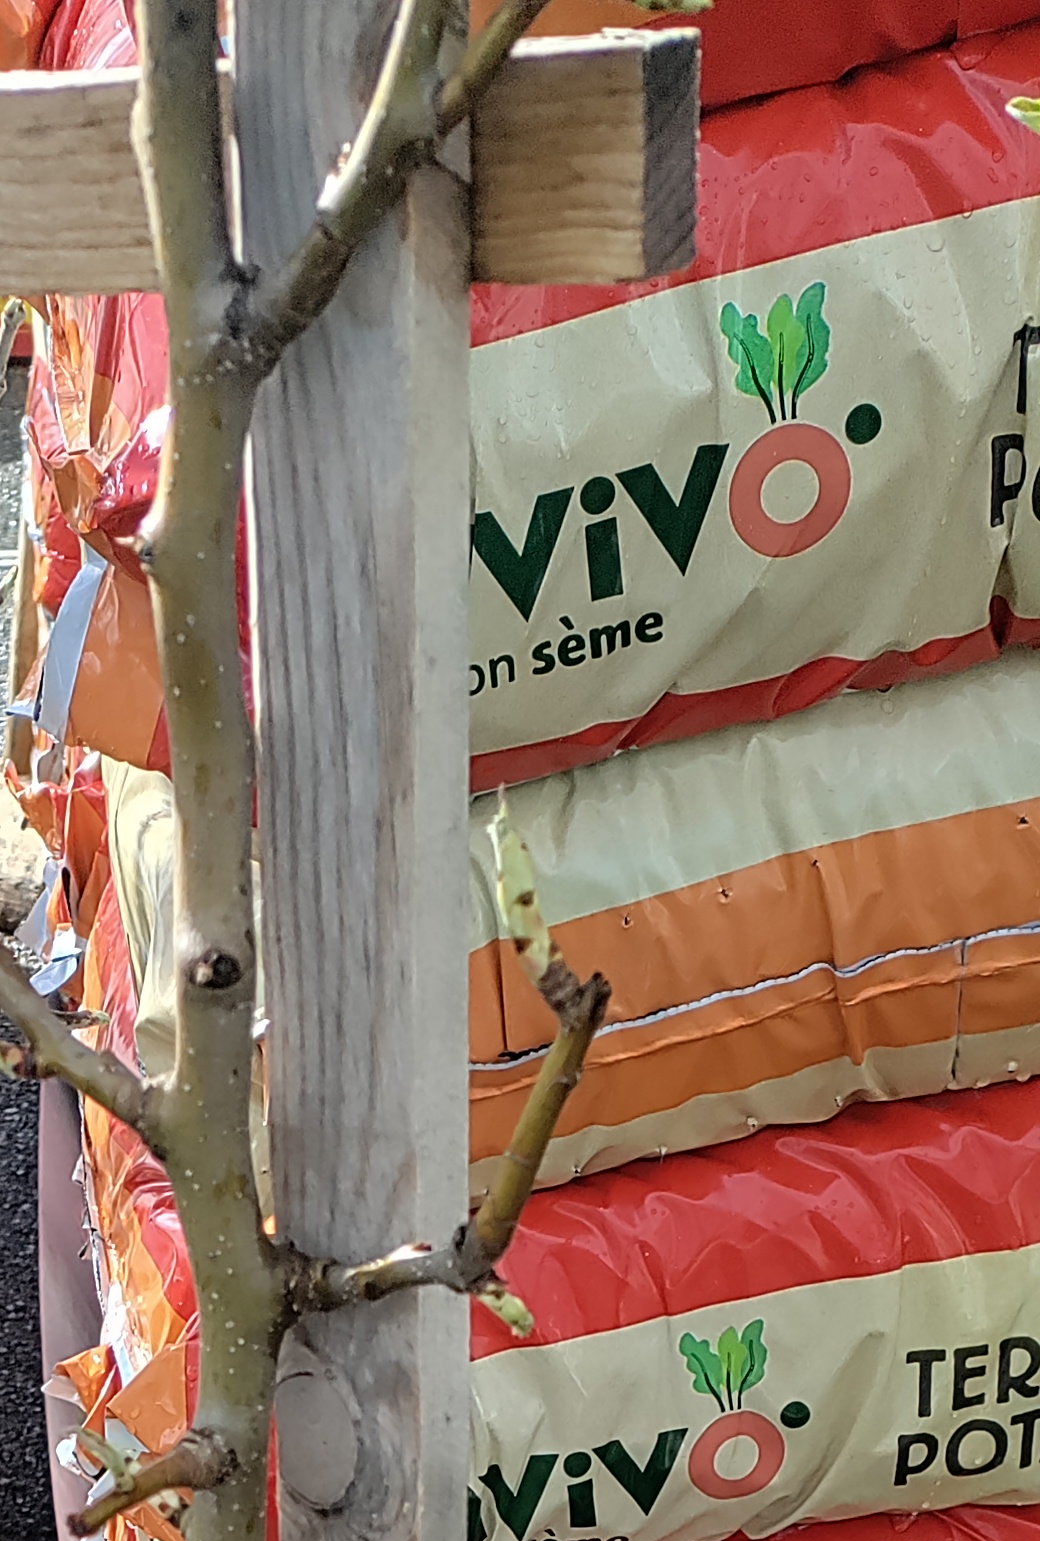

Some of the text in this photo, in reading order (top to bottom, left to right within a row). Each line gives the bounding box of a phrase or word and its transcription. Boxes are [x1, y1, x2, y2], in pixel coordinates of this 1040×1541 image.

[532, 609, 664, 676] sème
[906, 1336, 1040, 1418] TER
[893, 1408, 1040, 1487] POT
